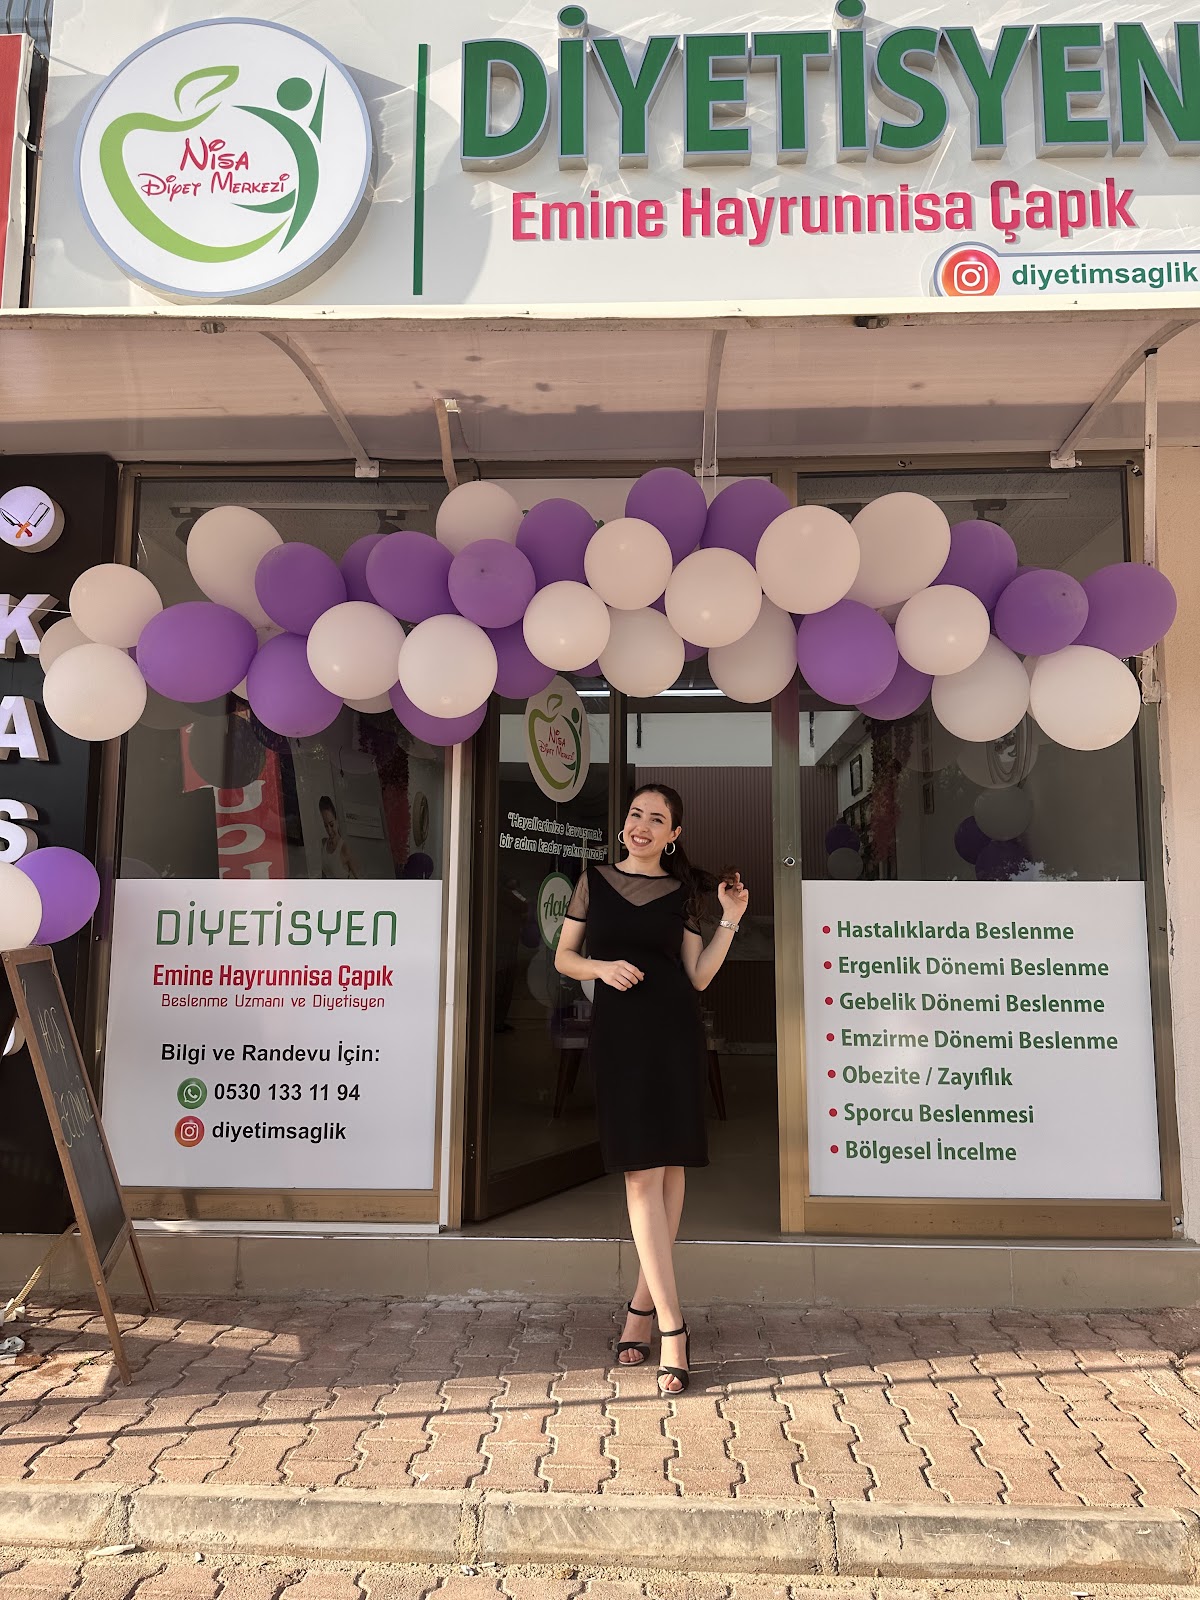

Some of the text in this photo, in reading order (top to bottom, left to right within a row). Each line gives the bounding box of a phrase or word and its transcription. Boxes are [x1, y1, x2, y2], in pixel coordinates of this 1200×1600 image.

[460, 0, 1200, 166] DİYETİSYEN
[511, 177, 1137, 246] Emine Hayrunnisa Çapık
[1010, 260, 1199, 291] diyetimsaglik
[156, 900, 398, 947] DİYETİSYEN
[837, 920, 1075, 940] Hastalıklarda Beslenme
[153, 964, 394, 991] Emine Hayrunnisa Çapık
[838, 957, 1110, 979] Ergenlik Dönemi Beslenme
[161, 993, 386, 1011] Beslenme Uzmanı ve Diyetisyen
[839, 991, 1106, 1013] Gebelik Dönemi Beslenme
[841, 1028, 1119, 1050] Emzirme Dönemi Beslenme
[161, 1041, 381, 1066] Bilgi ve Randevu İçin:
[842, 1065, 1014, 1091] Obezite / Zayıflık
[214, 1083, 361, 1101] 0530 133 11 94
[843, 1102, 1035, 1126] Sporcu Beslenmesi
[211, 1121, 348, 1144] diyetimsaglik
[845, 1137, 1018, 1165] Bölgesel İncelme
